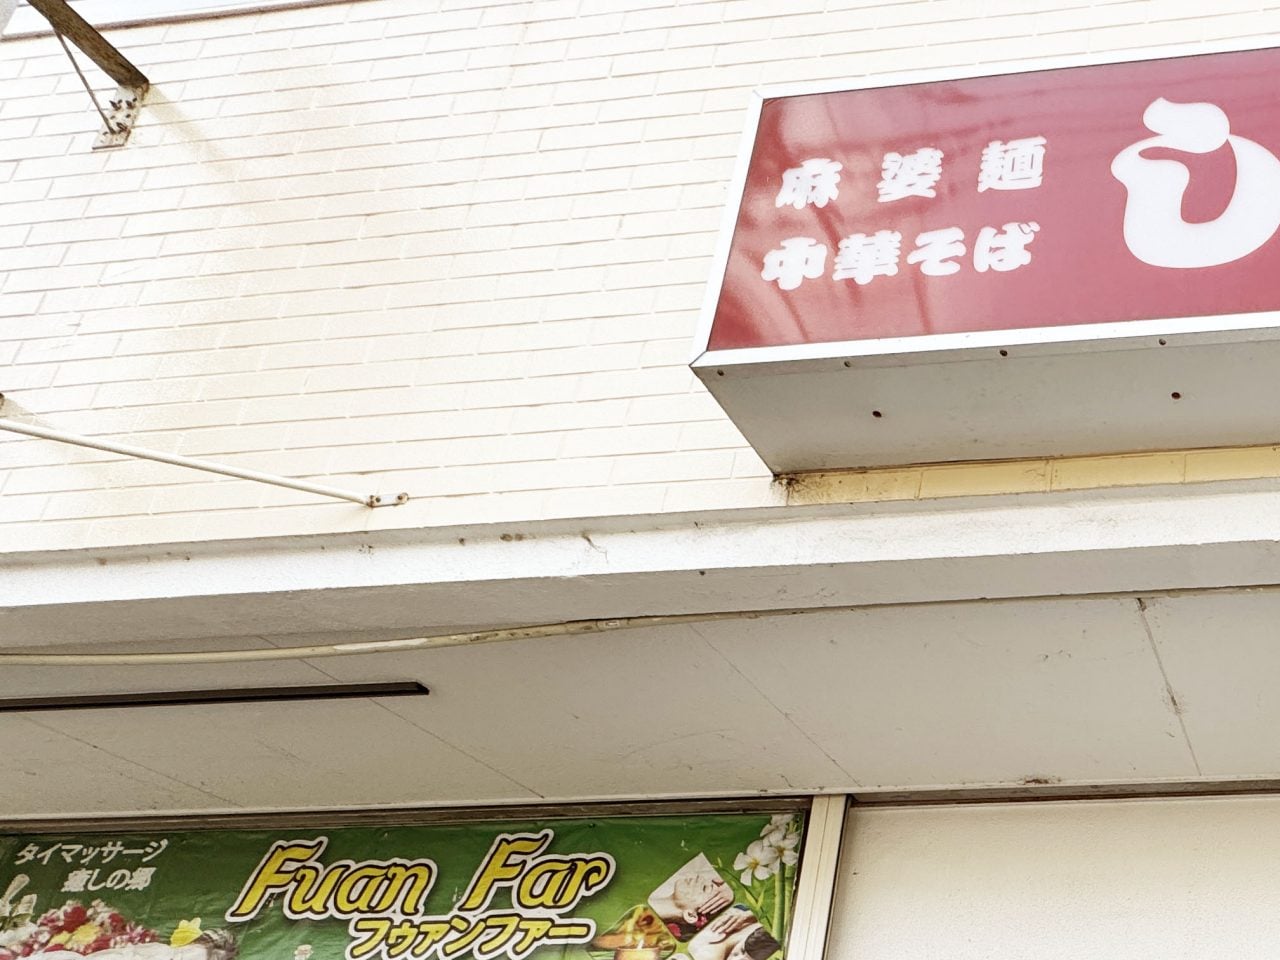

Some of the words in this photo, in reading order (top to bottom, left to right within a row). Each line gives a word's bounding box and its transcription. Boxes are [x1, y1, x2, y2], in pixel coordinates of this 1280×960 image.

[775, 135, 1047, 210] 麻婆麺
[761, 221, 1041, 290] 中華そば
[14, 838, 169, 866] タイマッサージ
[226, 838, 434, 917] Fuan
[456, 831, 613, 914] Far
